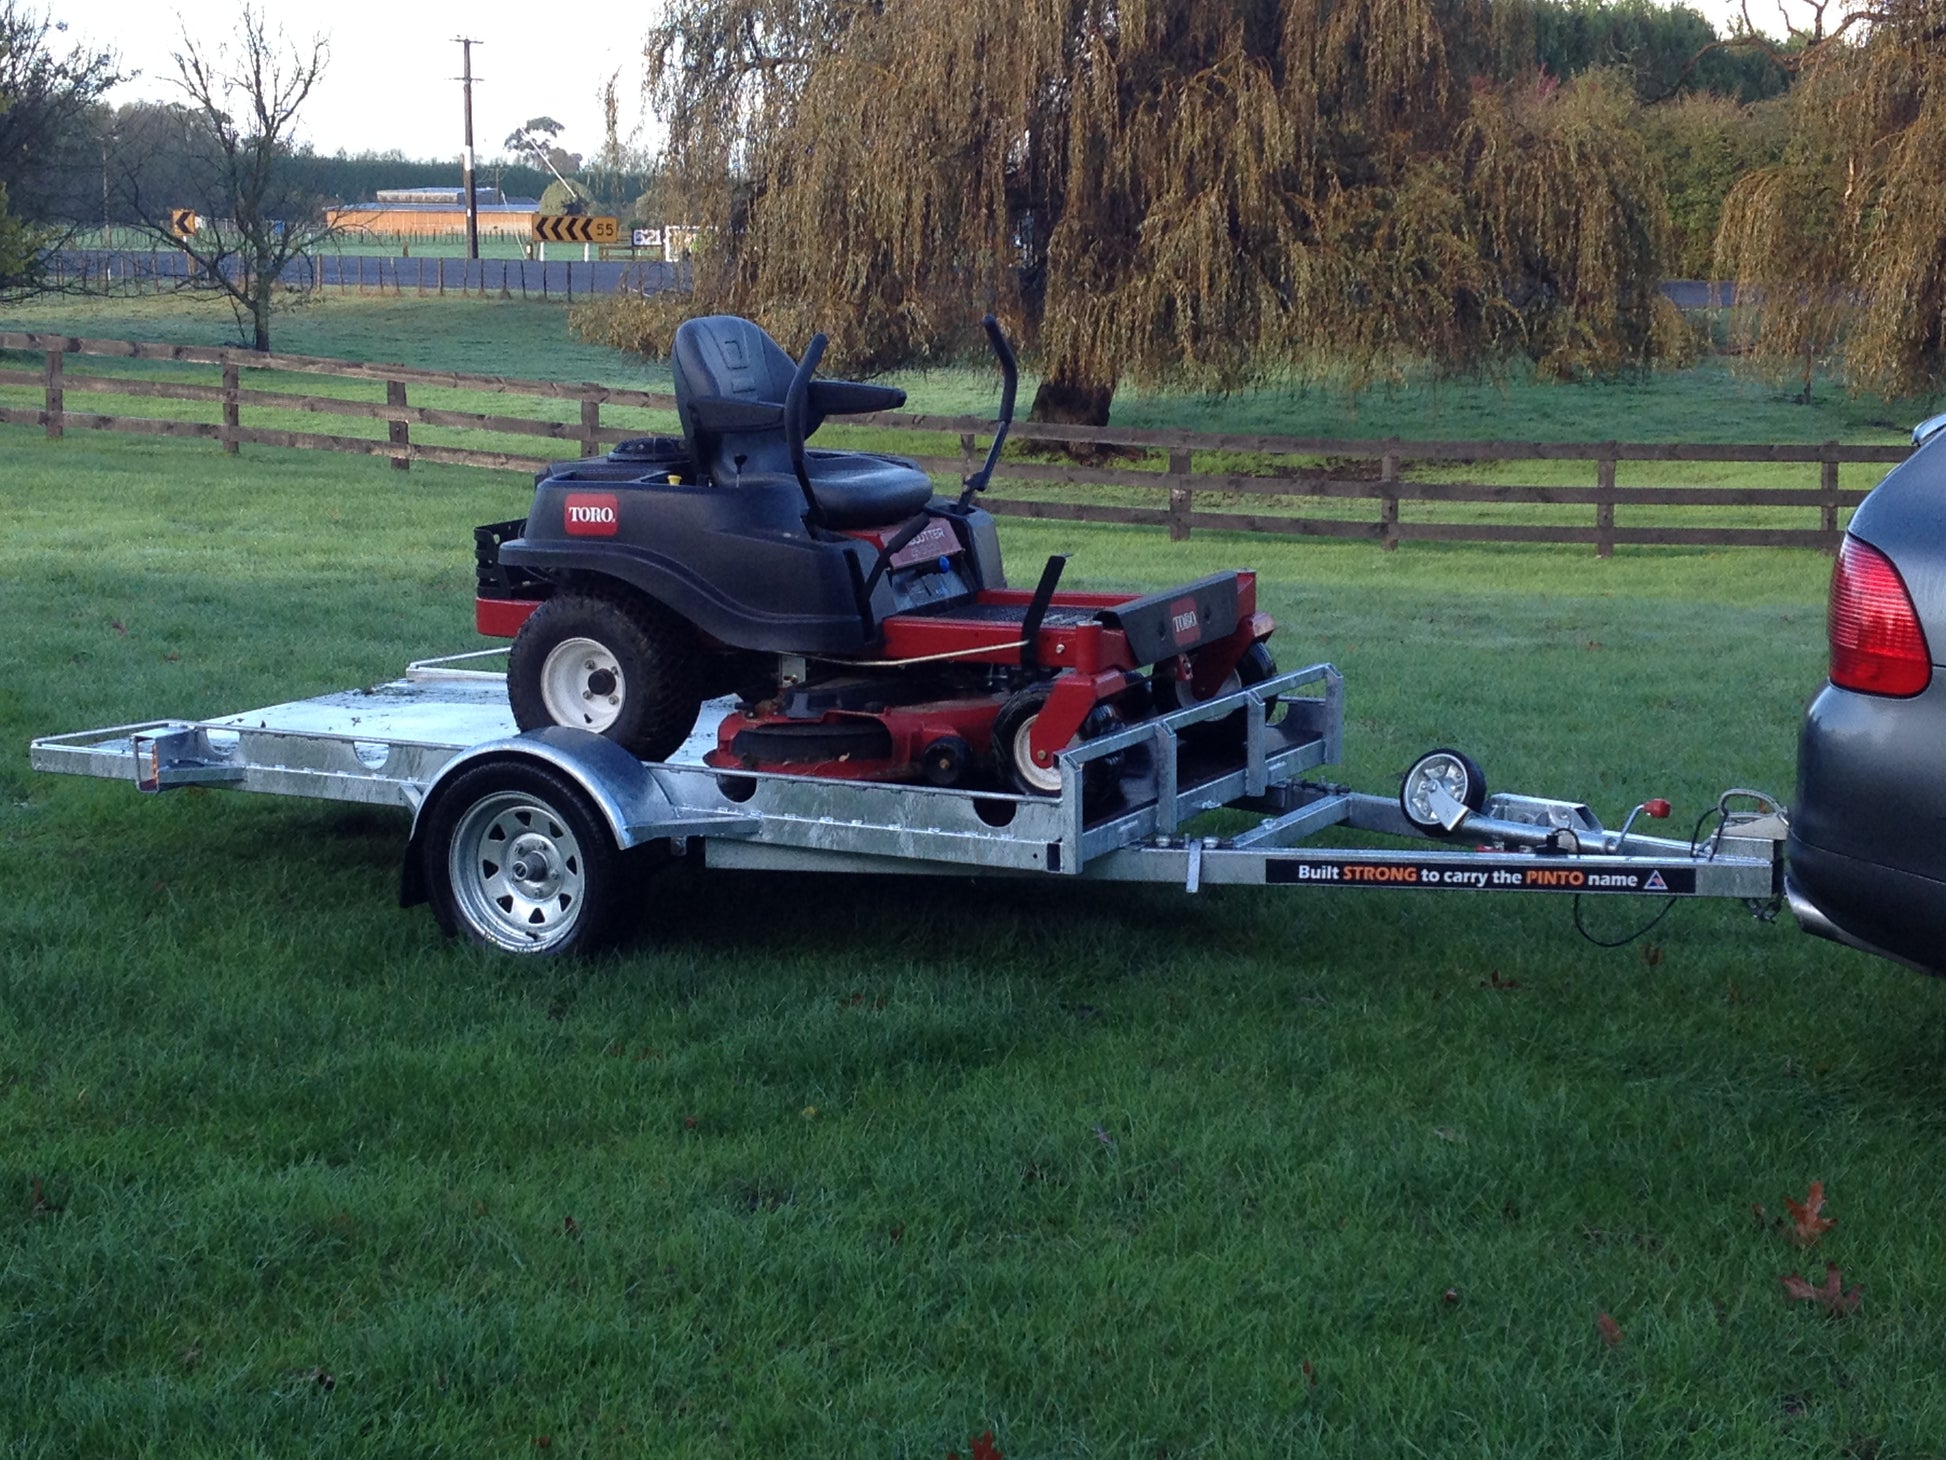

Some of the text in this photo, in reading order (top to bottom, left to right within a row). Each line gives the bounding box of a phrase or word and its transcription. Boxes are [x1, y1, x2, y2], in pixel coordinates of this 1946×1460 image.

[596, 223, 614, 236] 55
[568, 506, 614, 523] TORO
[1172, 611, 1199, 632] TORO
[1299, 865, 1638, 887] Built STRONG to carry the PINTO name
